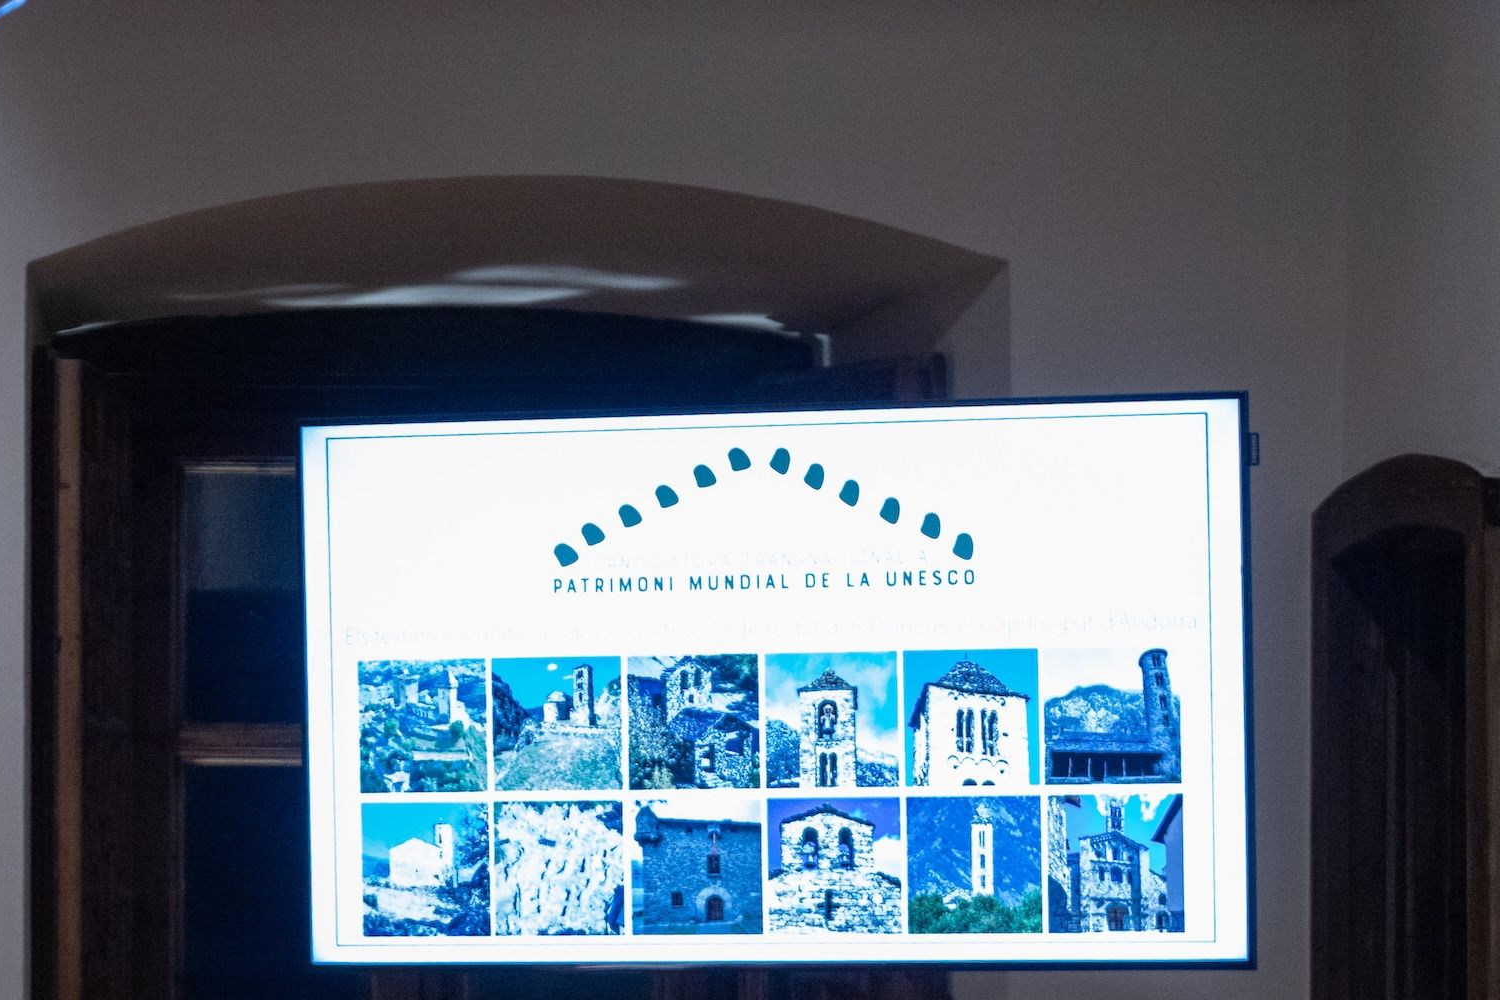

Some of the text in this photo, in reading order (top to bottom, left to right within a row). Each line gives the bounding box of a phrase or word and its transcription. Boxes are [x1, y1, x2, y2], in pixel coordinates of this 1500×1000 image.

[553, 569, 976, 593] PATRIMONI MUNDIAL DE LA UNESCO
